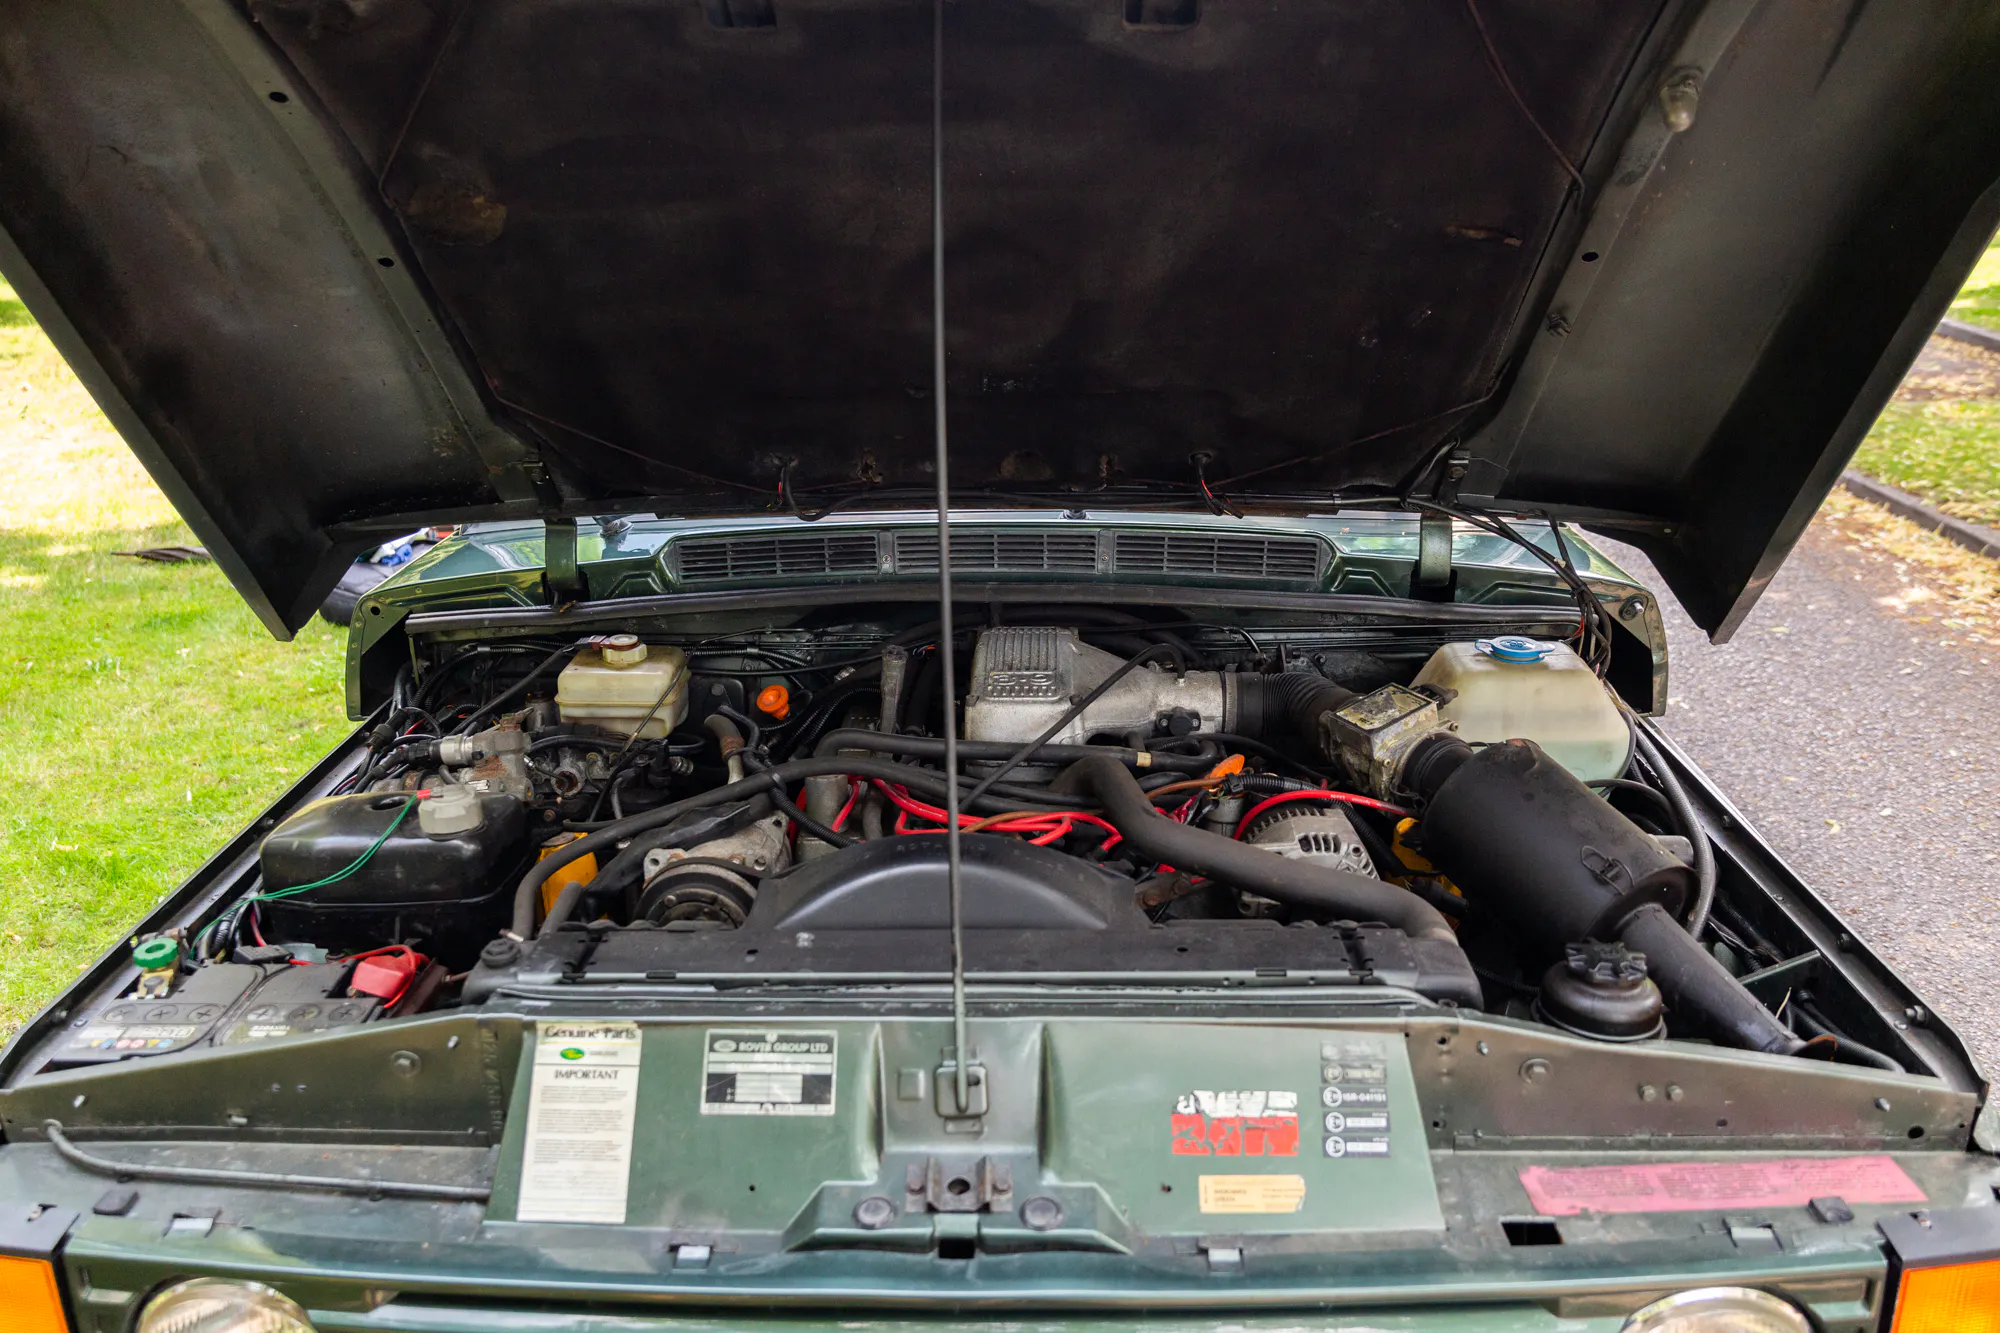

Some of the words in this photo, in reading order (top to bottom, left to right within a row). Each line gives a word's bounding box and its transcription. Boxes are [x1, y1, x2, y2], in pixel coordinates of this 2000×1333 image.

[544, 1025, 599, 1038] Genuine
[602, 1027, 637, 1039] Parts
[738, 1041, 772, 1053] ROVER
[773, 1042, 809, 1053] GROUP
[810, 1042, 829, 1053] LTD
[554, 1069, 620, 1080] IMPORTANT
